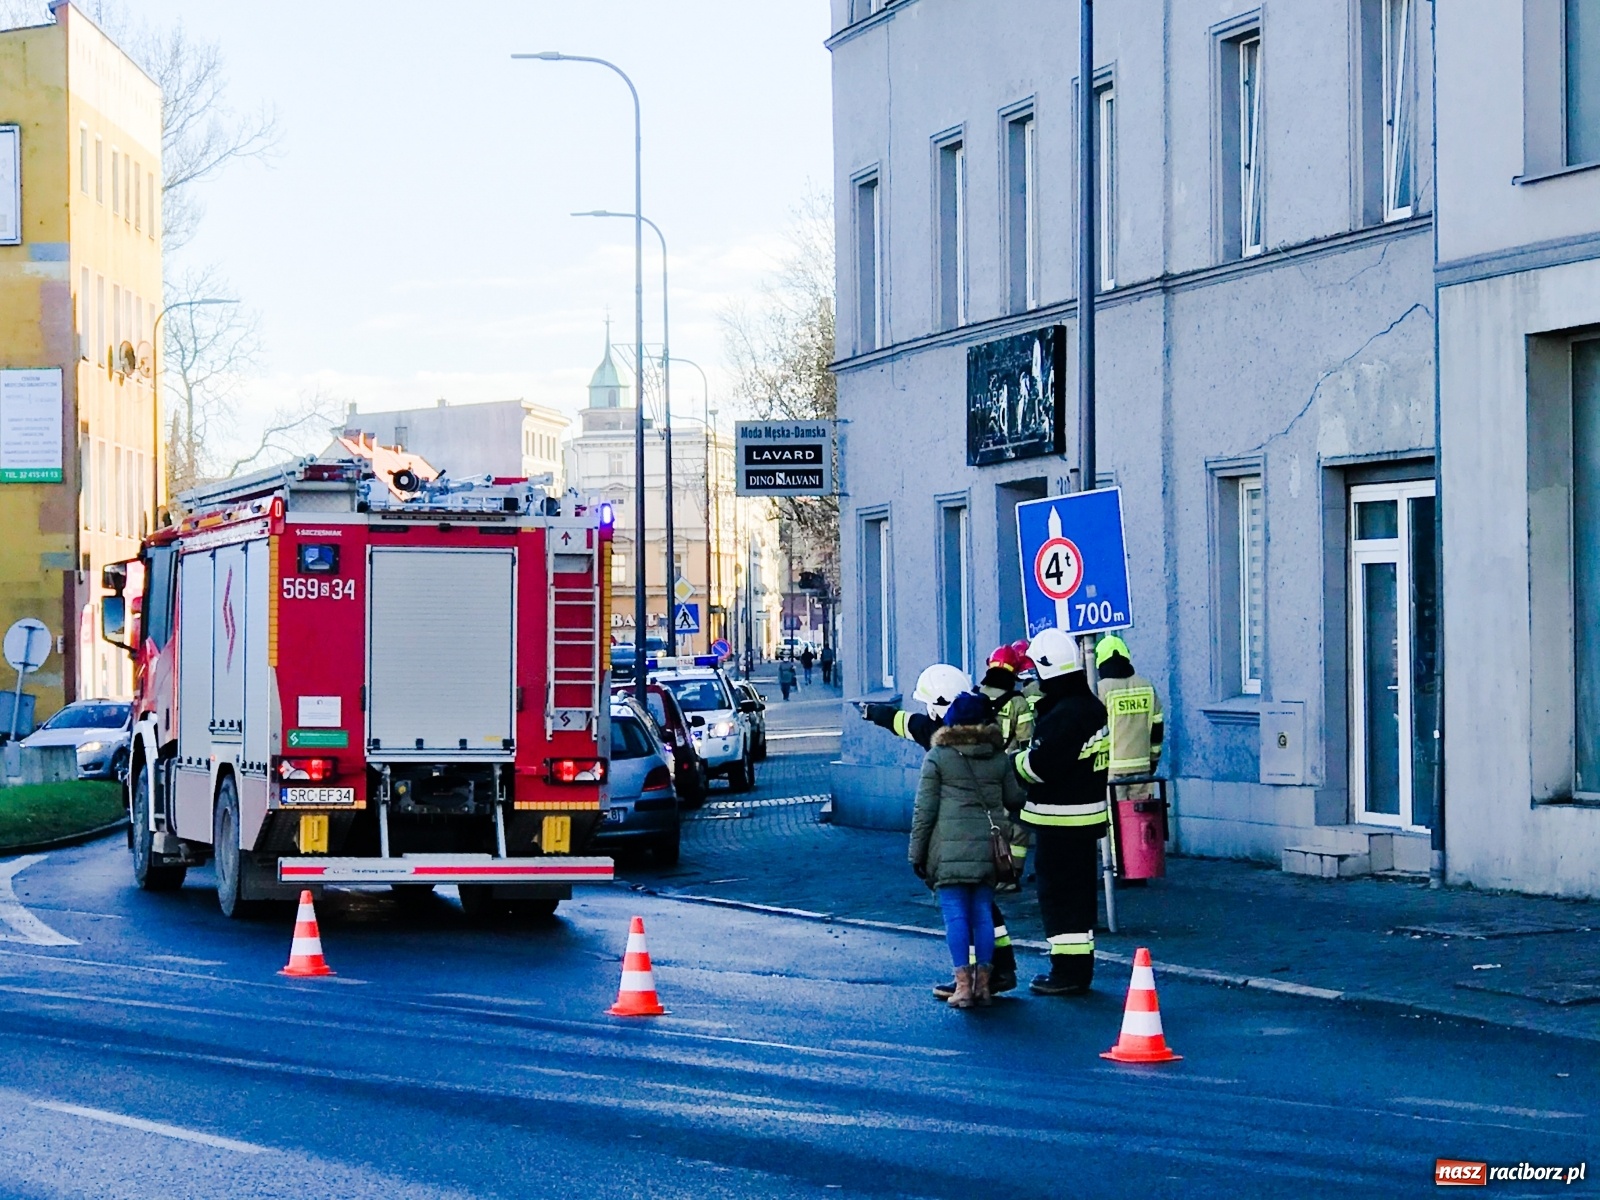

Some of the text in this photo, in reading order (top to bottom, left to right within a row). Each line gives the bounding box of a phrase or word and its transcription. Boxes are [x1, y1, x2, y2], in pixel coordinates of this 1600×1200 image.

[741, 426, 826, 441] Moda Męska-Damska
[752, 450, 815, 460] LAVARD
[749, 472, 820, 486] DINO SALVANI
[290, 789, 351, 802] SRC EF34
